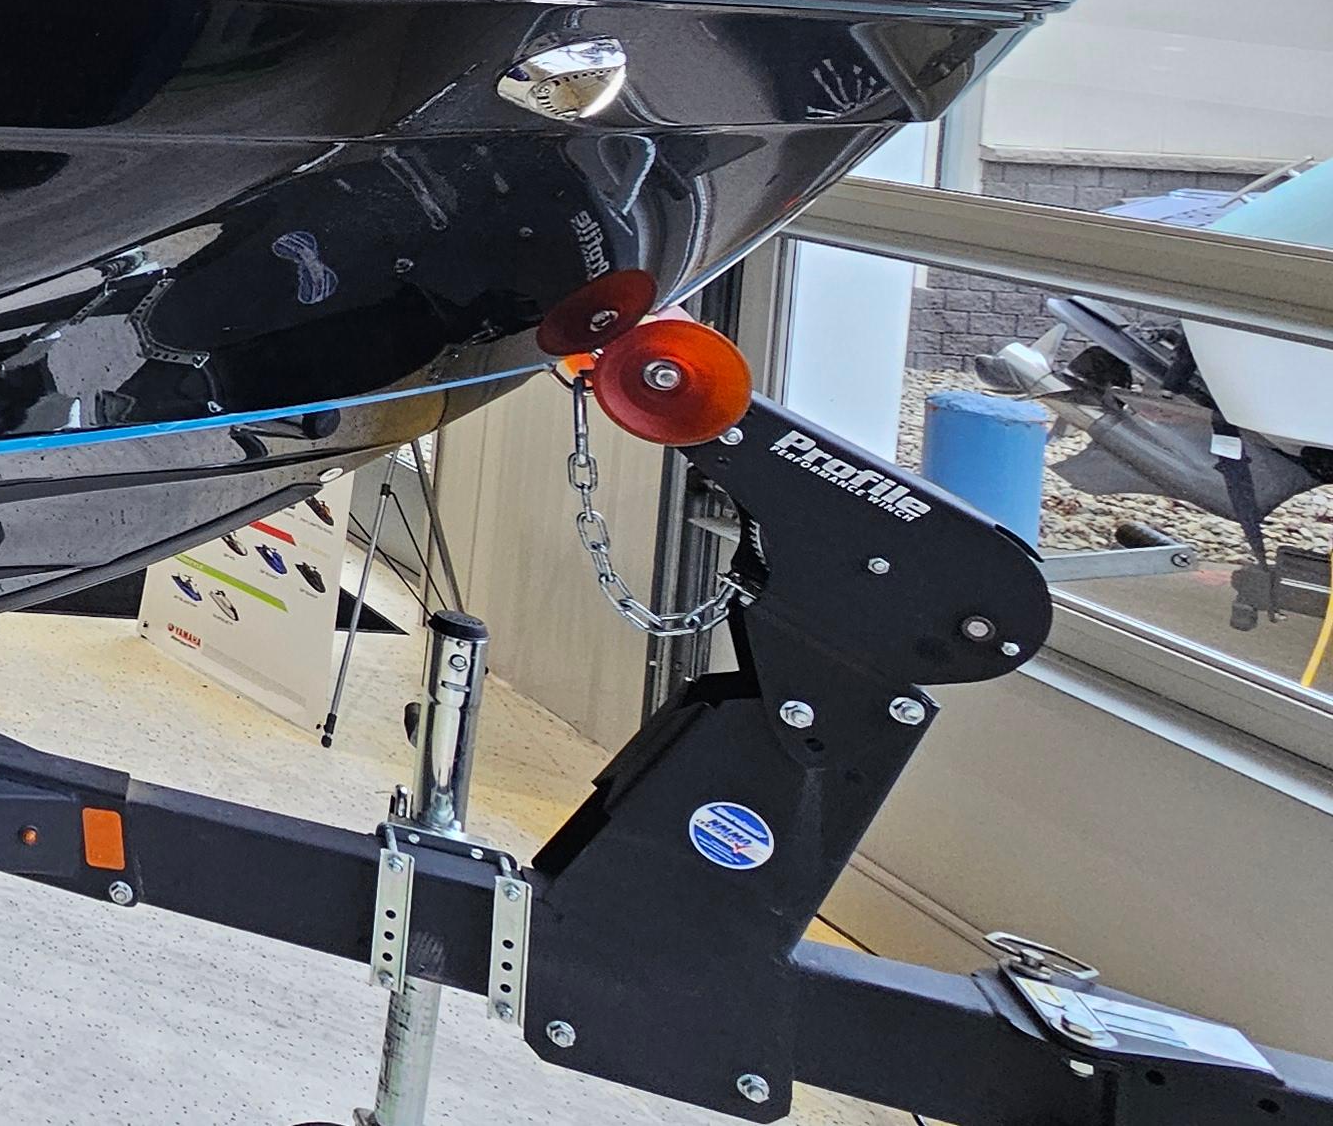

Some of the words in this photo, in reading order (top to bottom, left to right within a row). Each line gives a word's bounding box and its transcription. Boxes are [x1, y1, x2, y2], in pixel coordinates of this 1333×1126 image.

[769, 445, 867, 497] PERFORMANCE
[867, 495, 916, 522] WINCH
[774, 430, 932, 515] Profile
